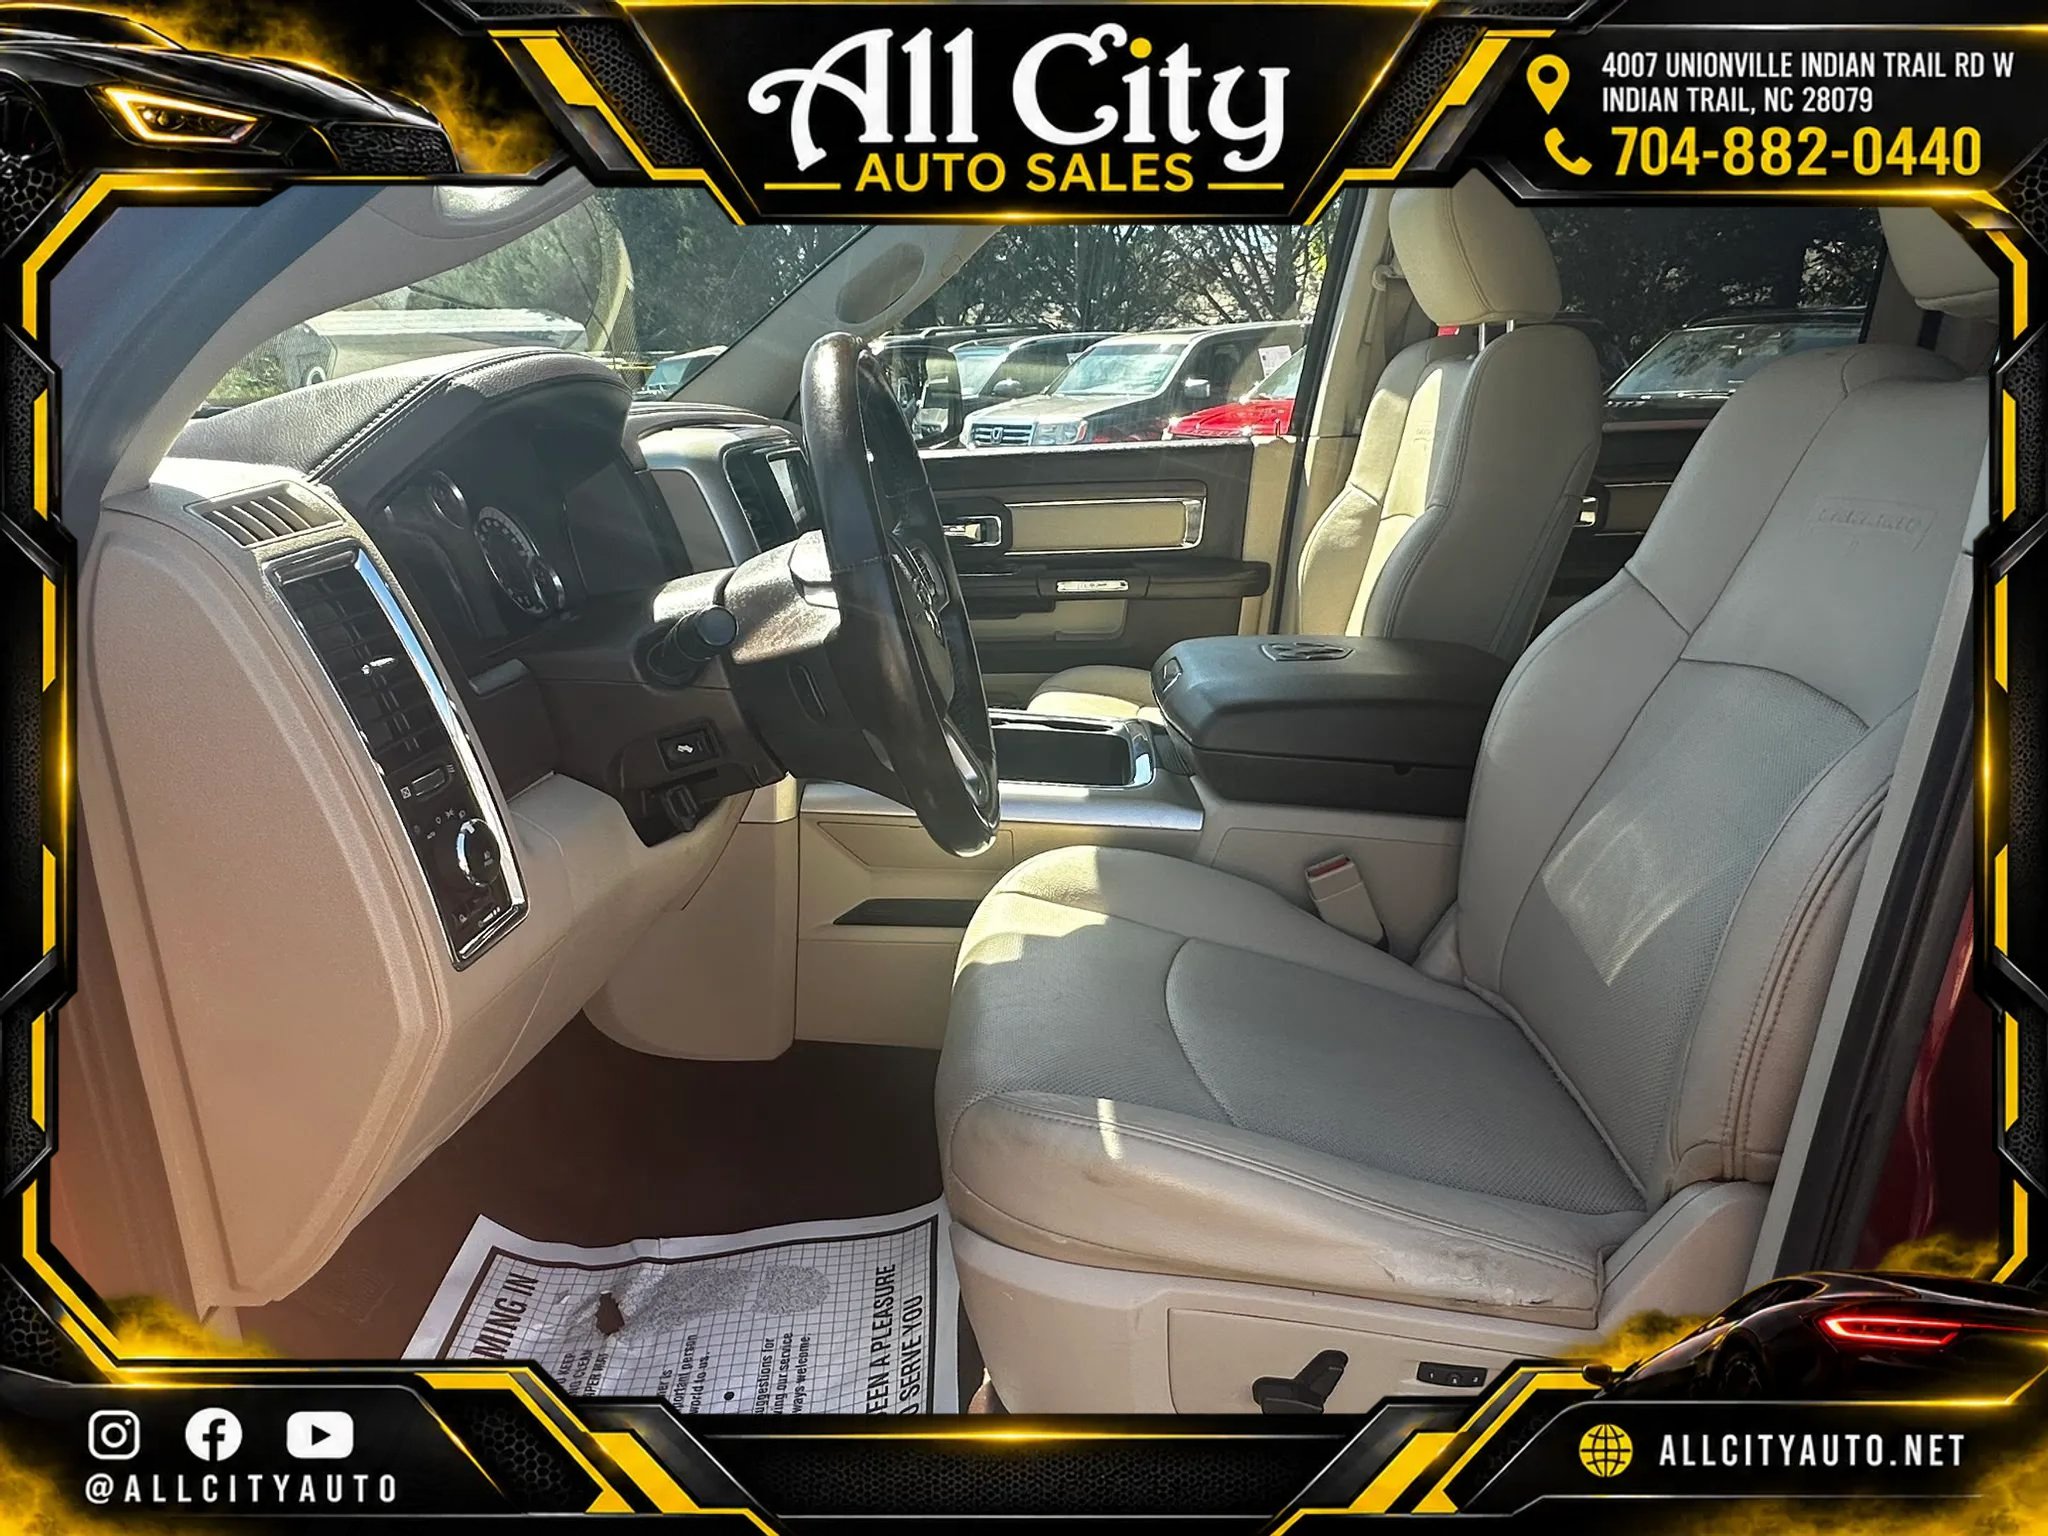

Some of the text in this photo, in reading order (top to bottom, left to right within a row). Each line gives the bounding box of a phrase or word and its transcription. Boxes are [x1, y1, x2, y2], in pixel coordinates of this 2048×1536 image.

[472, 1273, 539, 1360] MING IN
[902, 1294, 923, 1336] YOU
[779, 1332, 794, 1372] service
[866, 1263, 896, 1414] EEN A PLEASURE
[560, 1352, 575, 1375] KEEP
[573, 1351, 593, 1379] CLEAN
[673, 1334, 698, 1410] portant person
[696, 1371, 706, 1384] to
[701, 1351, 710, 1368] us.
[754, 1338, 775, 1414] uggestions for
[777, 1374, 788, 1390] our
[900, 1335, 922, 1402] SERVE
[792, 1386, 807, 1413] ways
